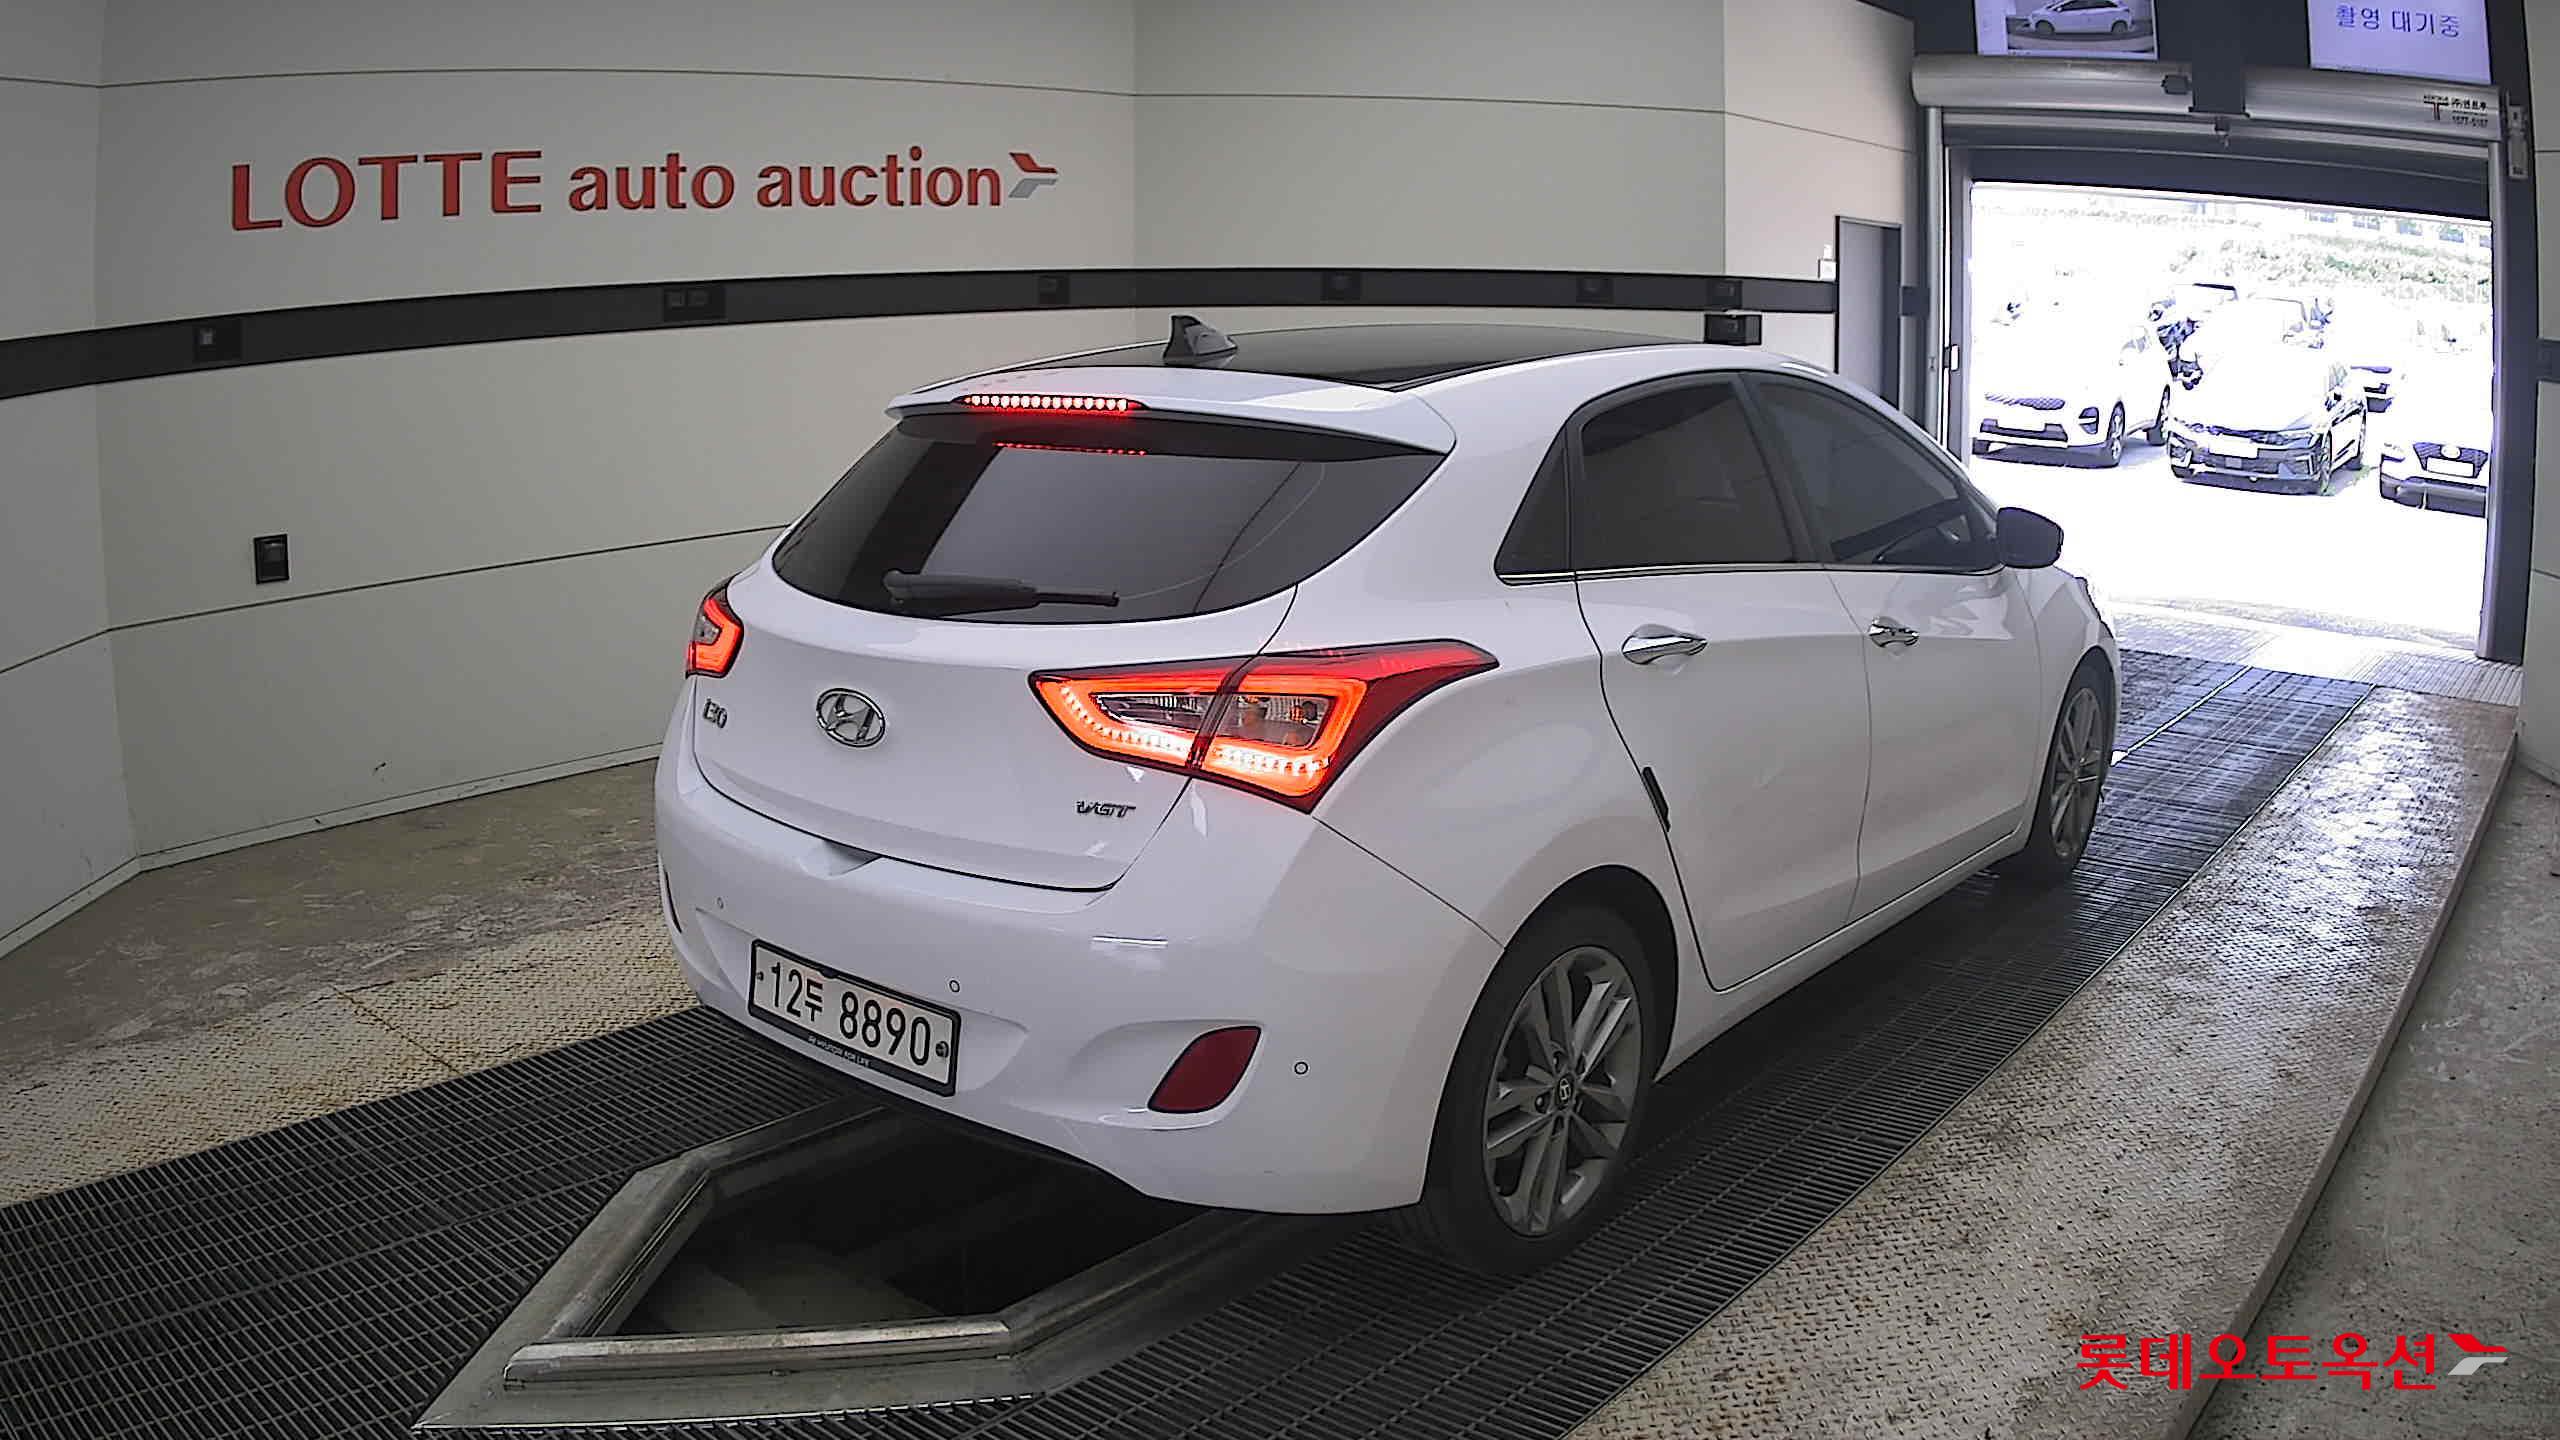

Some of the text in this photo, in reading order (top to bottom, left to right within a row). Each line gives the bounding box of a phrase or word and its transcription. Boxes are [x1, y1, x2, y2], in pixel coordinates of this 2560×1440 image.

[2391, 10, 2460, 39] 대기중
[232, 146, 1001, 231] LOTTE auto auction
[771, 961, 823, 1022] 12두
[839, 990, 931, 1066] 8890
